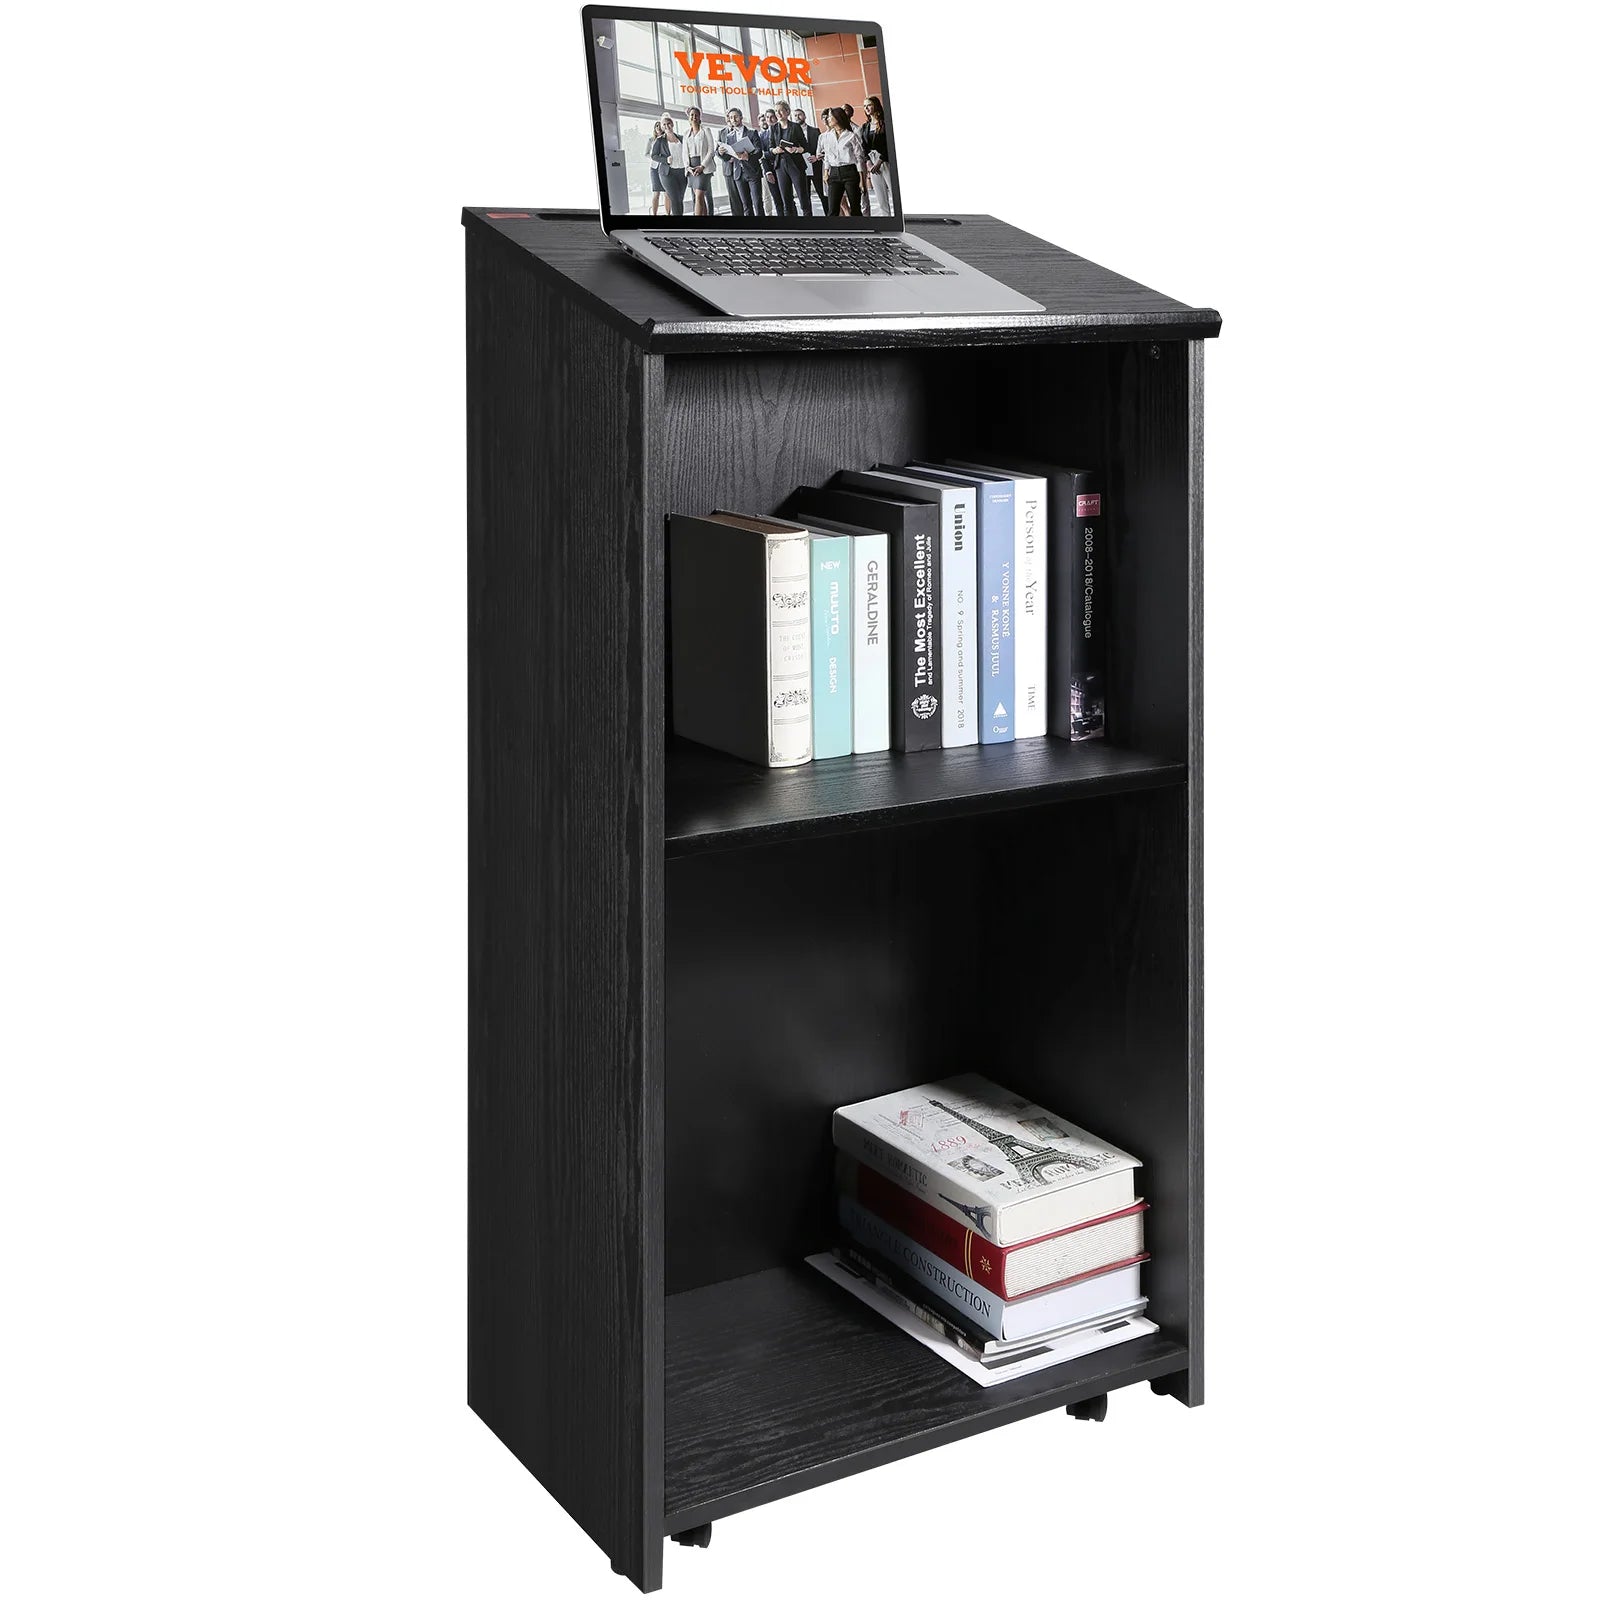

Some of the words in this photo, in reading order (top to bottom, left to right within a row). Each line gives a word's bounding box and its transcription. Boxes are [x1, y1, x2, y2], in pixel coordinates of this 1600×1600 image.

[674, 51, 812, 84] VEVOR
[758, 88, 783, 96] HALF
[786, 88, 813, 97] PRICE
[954, 503, 966, 551] Union
[1025, 500, 1037, 554] Person
[820, 560, 840, 571] NEW
[914, 533, 926, 609] Excellent
[867, 560, 878, 646] GERALDINE
[1025, 580, 1037, 616] Year
[914, 612, 926, 653] Most
[991, 609, 1000, 650] RASMUS
[829, 656, 837, 694] DESIGN
[914, 656, 926, 688] The
[1027, 683, 1036, 711] TIME
[930, 1135, 967, 1153] 1889
[903, 1248, 991, 1318] CONSTRUCTION
